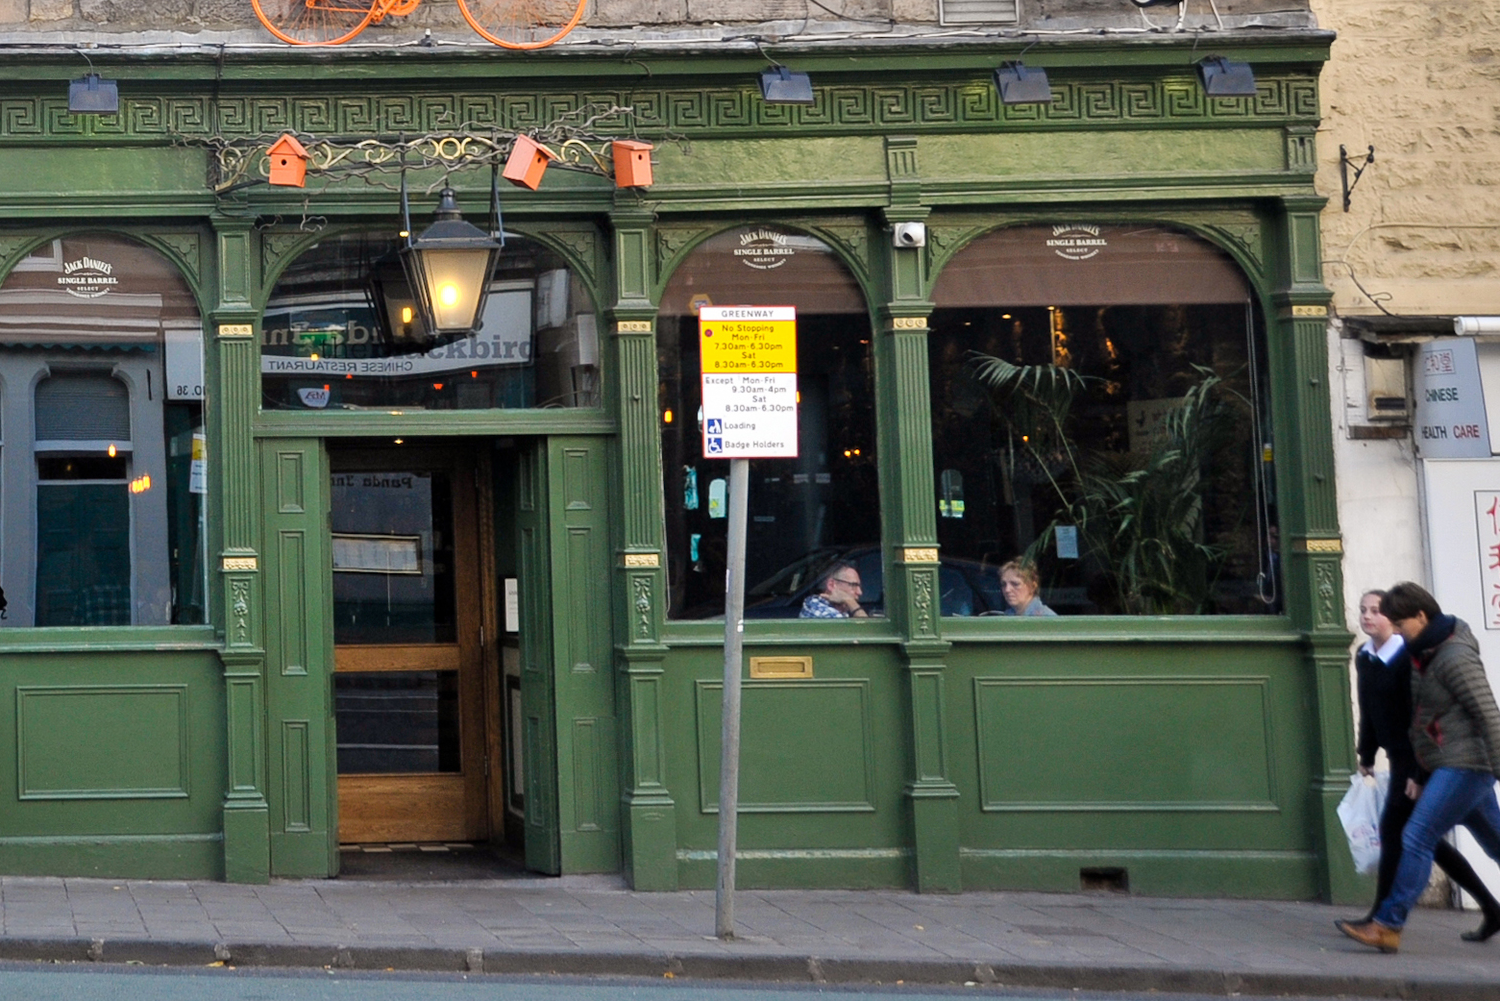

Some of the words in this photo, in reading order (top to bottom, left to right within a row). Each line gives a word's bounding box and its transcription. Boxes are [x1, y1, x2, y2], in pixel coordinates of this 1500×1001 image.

[740, 231, 758, 246] JACK
[1076, 238, 1108, 246] BARREL
[733, 248, 763, 256] SINGLE
[64, 260, 83, 275] JACK
[83, 256, 113, 275] DANIEL'S
[721, 310, 774, 318] GREENWAY
[722, 324, 734, 332] No
[737, 324, 774, 333] Stopping
[714, 342, 783, 351] 7.30am-6.30pm
[714, 360, 784, 369] 8.30am-6.30pm
[705, 377, 734, 385] Except
[742, 376, 776, 384] Mon-Fri
[731, 385, 787, 394] 9.30am-4pm
[752, 395, 767, 403] Sat
[1425, 387, 1459, 402] CHINESE
[725, 404, 794, 412] 8.30am-6.30pm
[724, 422, 756, 430] Loading
[1422, 425, 1448, 439] HEALTH
[1453, 424, 1480, 439] CARE
[725, 441, 750, 449] Badge
[752, 440, 785, 448] Holders
